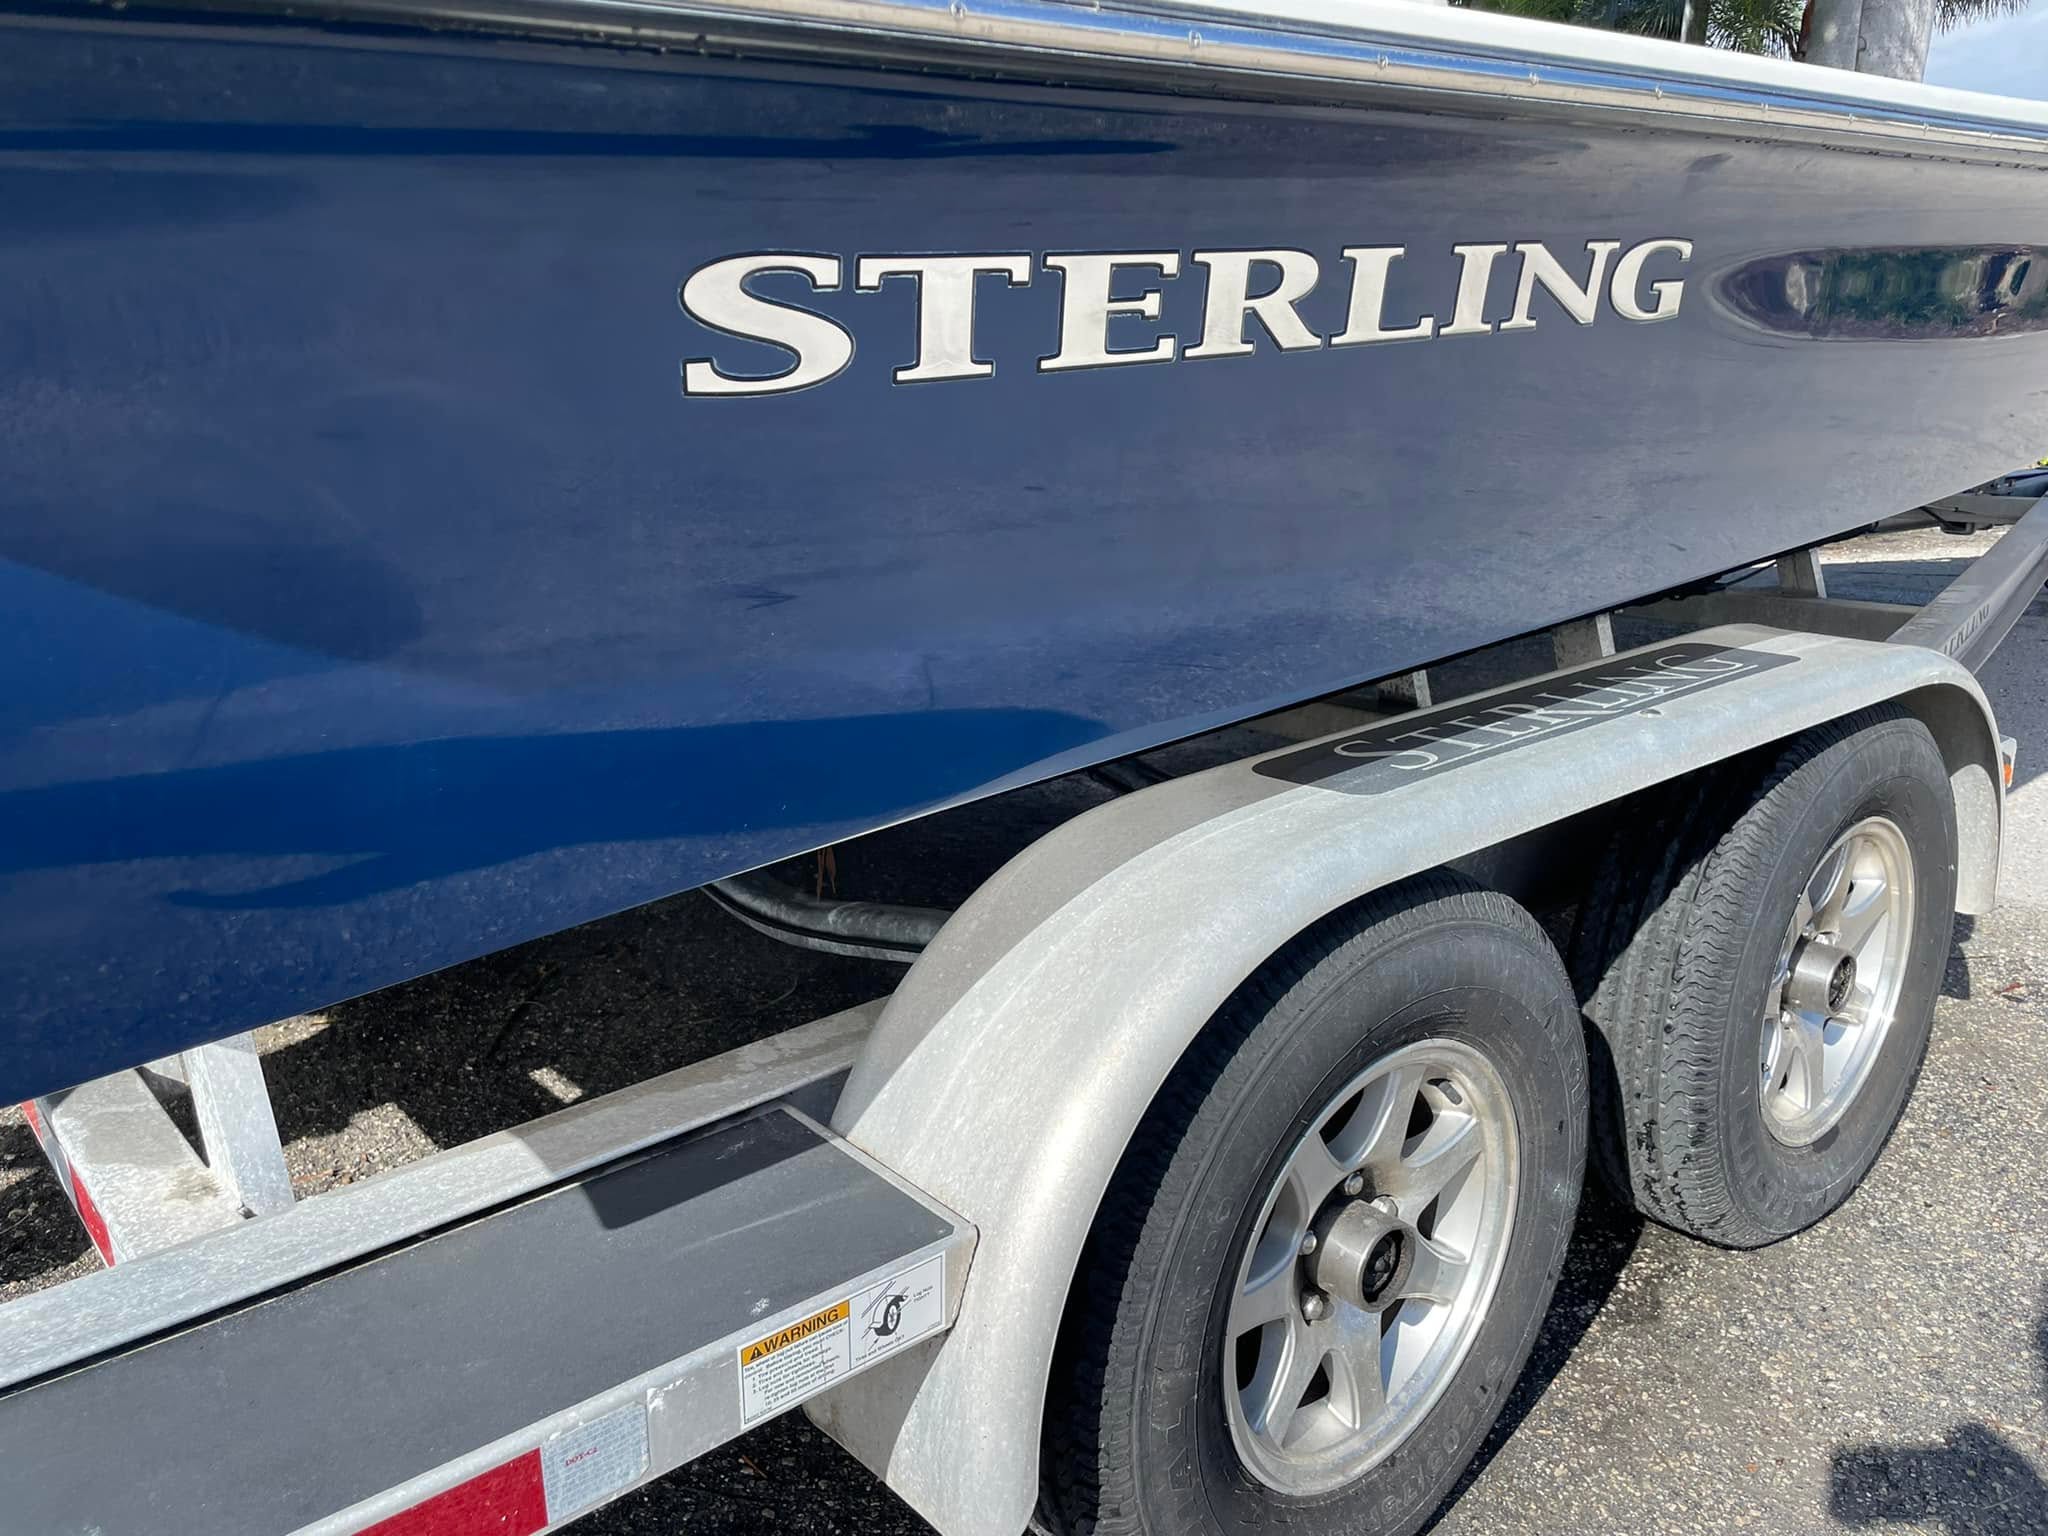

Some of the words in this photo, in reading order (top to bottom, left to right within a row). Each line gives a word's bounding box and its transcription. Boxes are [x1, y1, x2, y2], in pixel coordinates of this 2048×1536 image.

[682, 239, 1694, 396] STERLING
[1334, 654, 1744, 770] STERLING
[765, 1309, 839, 1353] WARNING
[566, 1448, 597, 1466] DOT-C2
